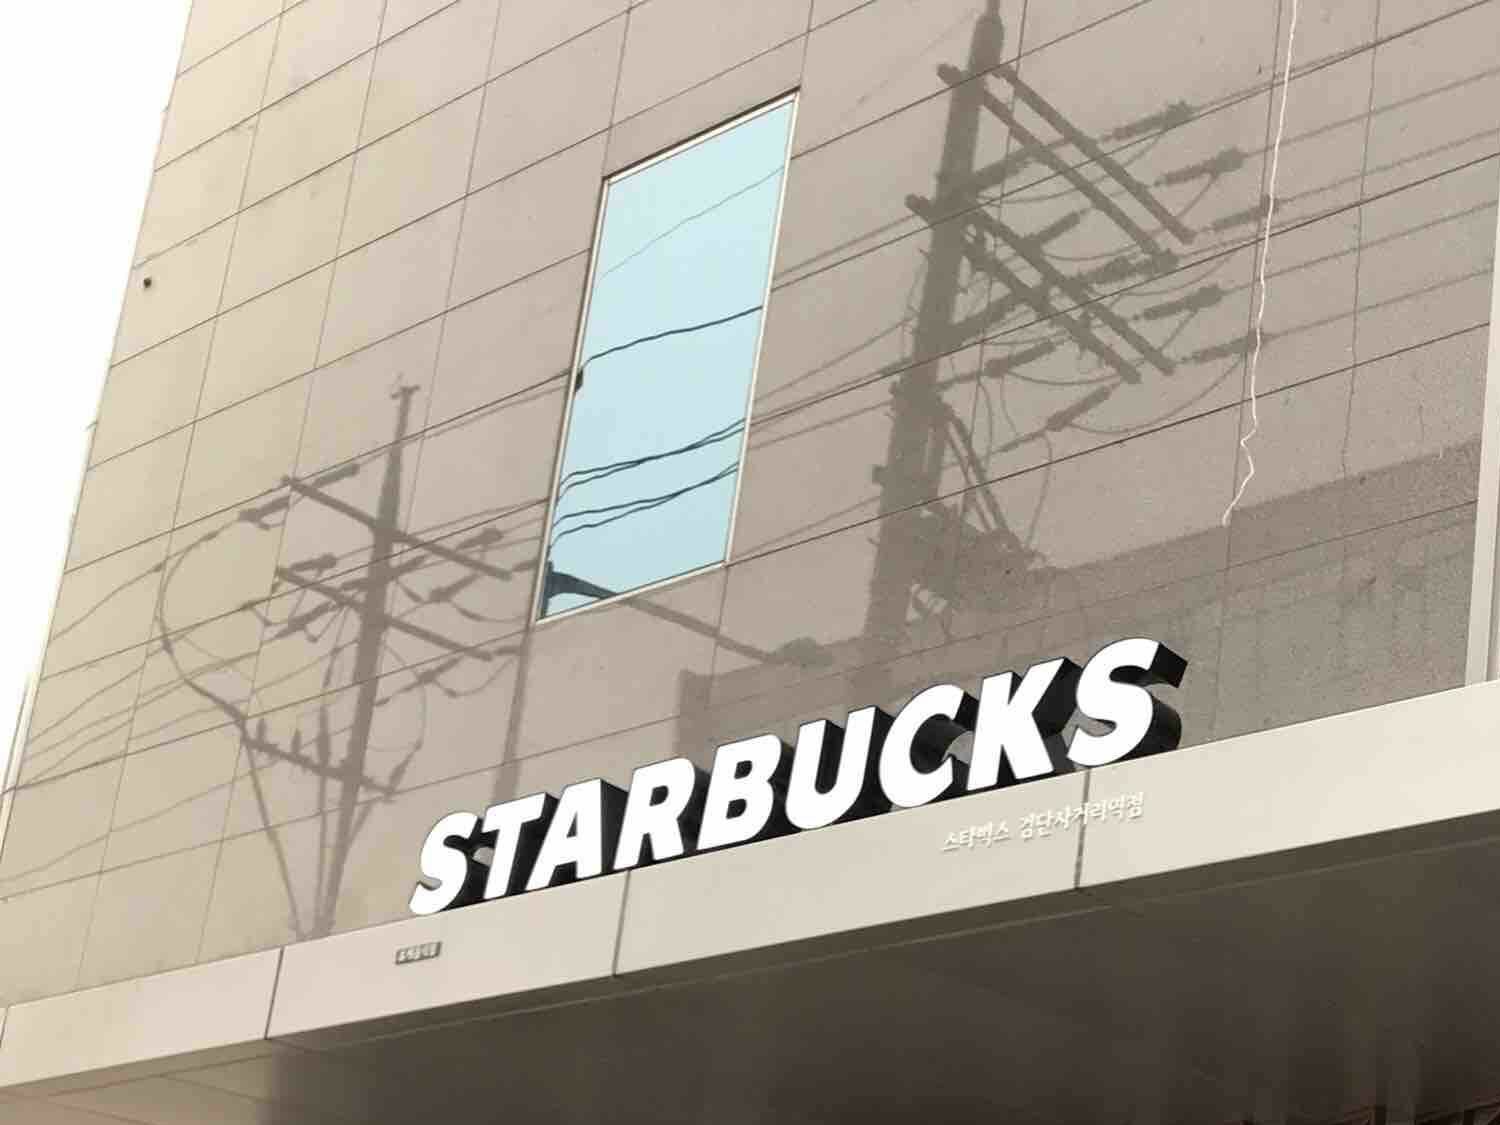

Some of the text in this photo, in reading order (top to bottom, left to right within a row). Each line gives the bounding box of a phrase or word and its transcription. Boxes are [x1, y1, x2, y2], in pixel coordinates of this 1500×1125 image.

[408, 637, 1172, 915] STARBUCKS
[942, 792, 1144, 851] 스타벅스 검단사거리역점
